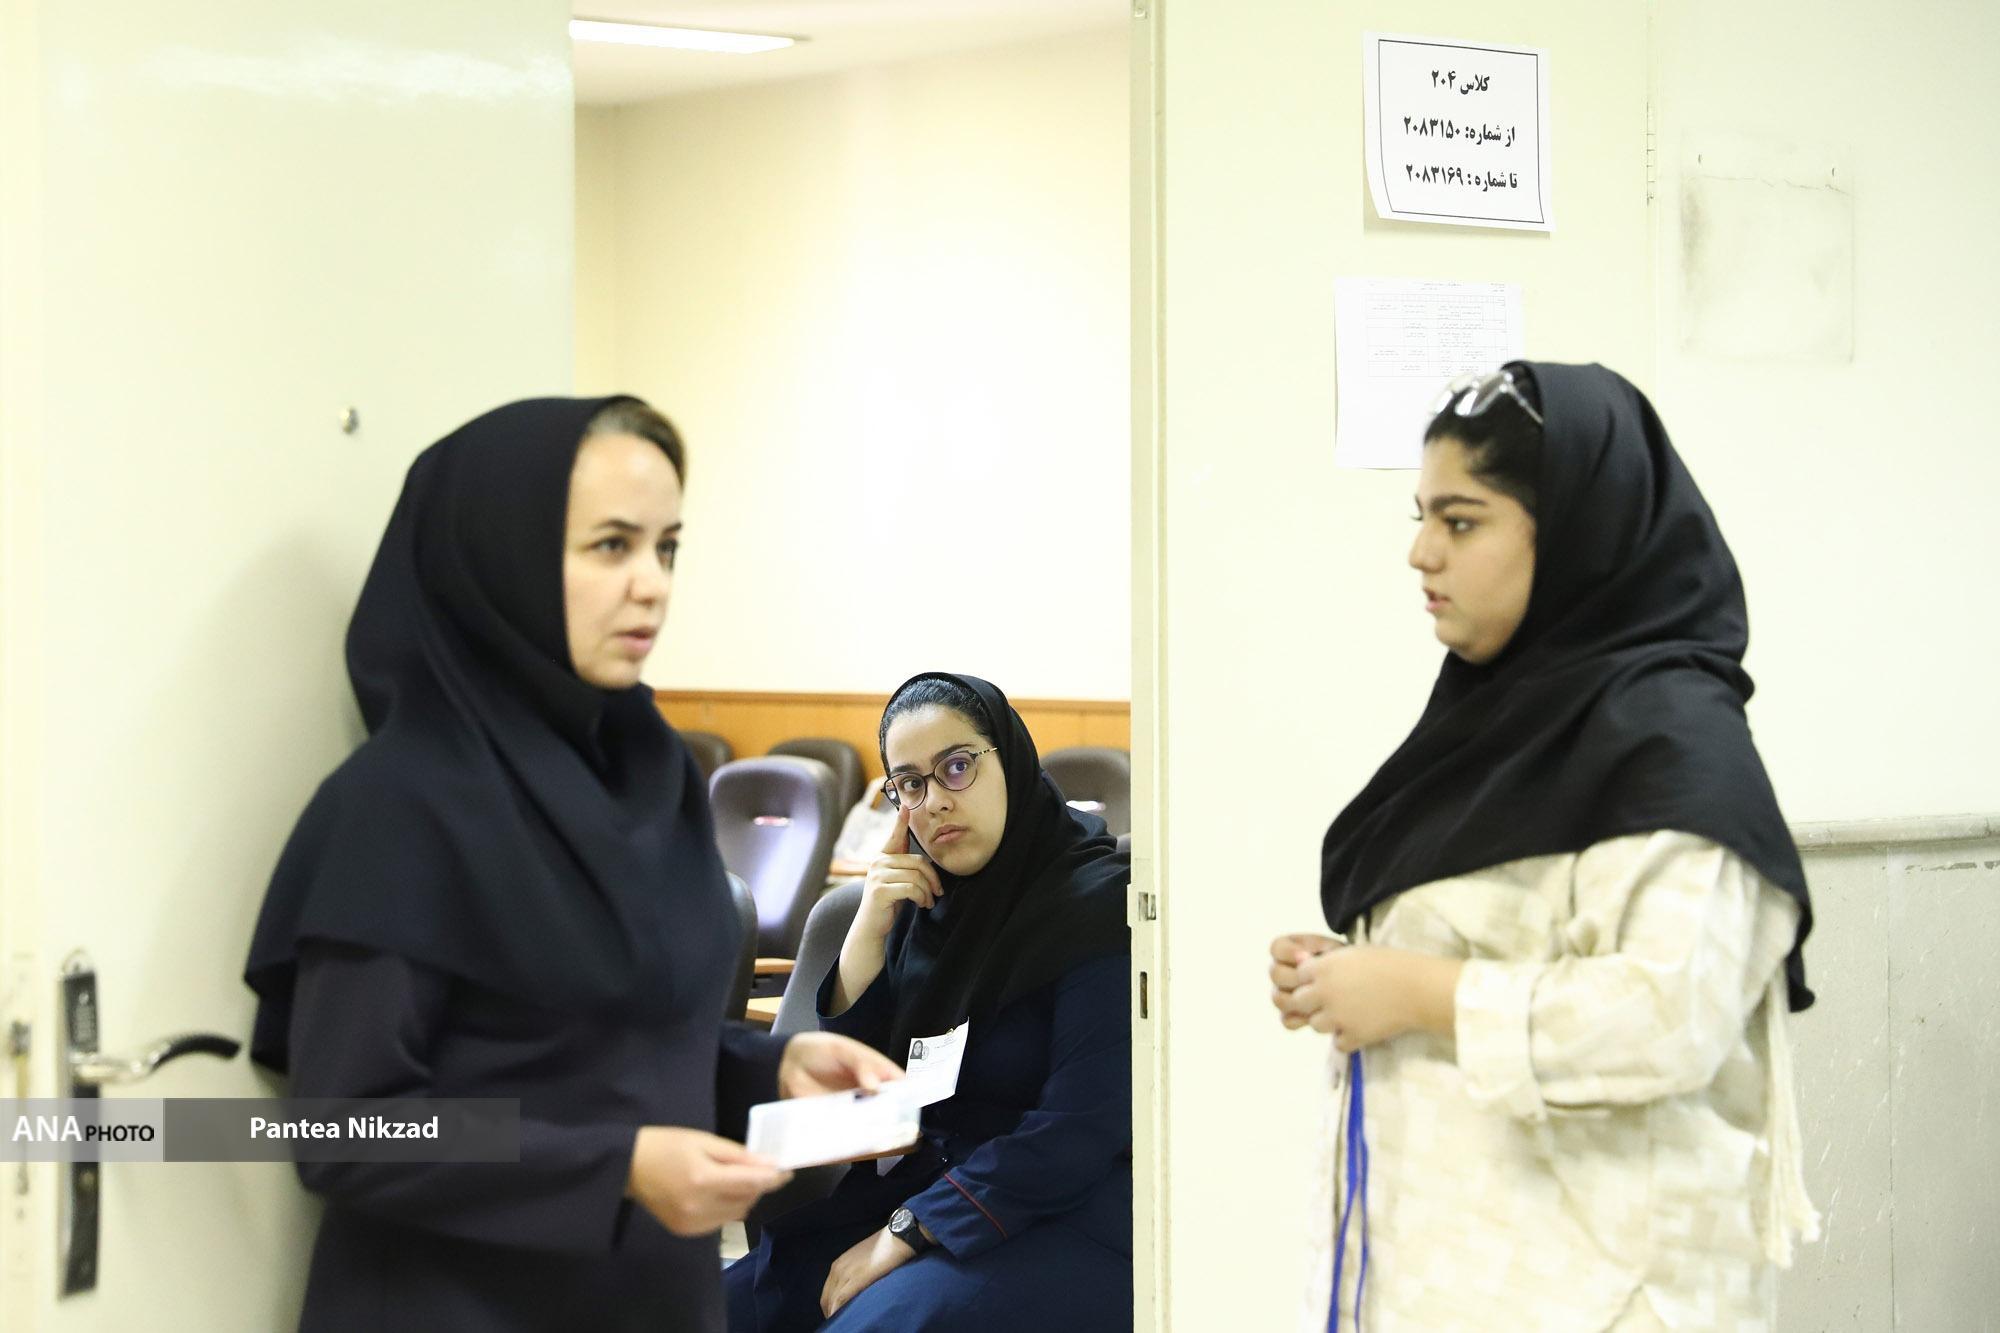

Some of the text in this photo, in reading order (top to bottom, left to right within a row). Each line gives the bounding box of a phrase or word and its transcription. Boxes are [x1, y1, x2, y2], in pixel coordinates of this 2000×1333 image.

[1431, 69, 1490, 95] کلاس ۲۰۴
[1403, 115, 1515, 147] از شماره: ۲۰۸۳۱۵۰
[1405, 163, 1464, 187] ۲۰۸۳۱۶۹
[1509, 172, 1518, 189] تا
